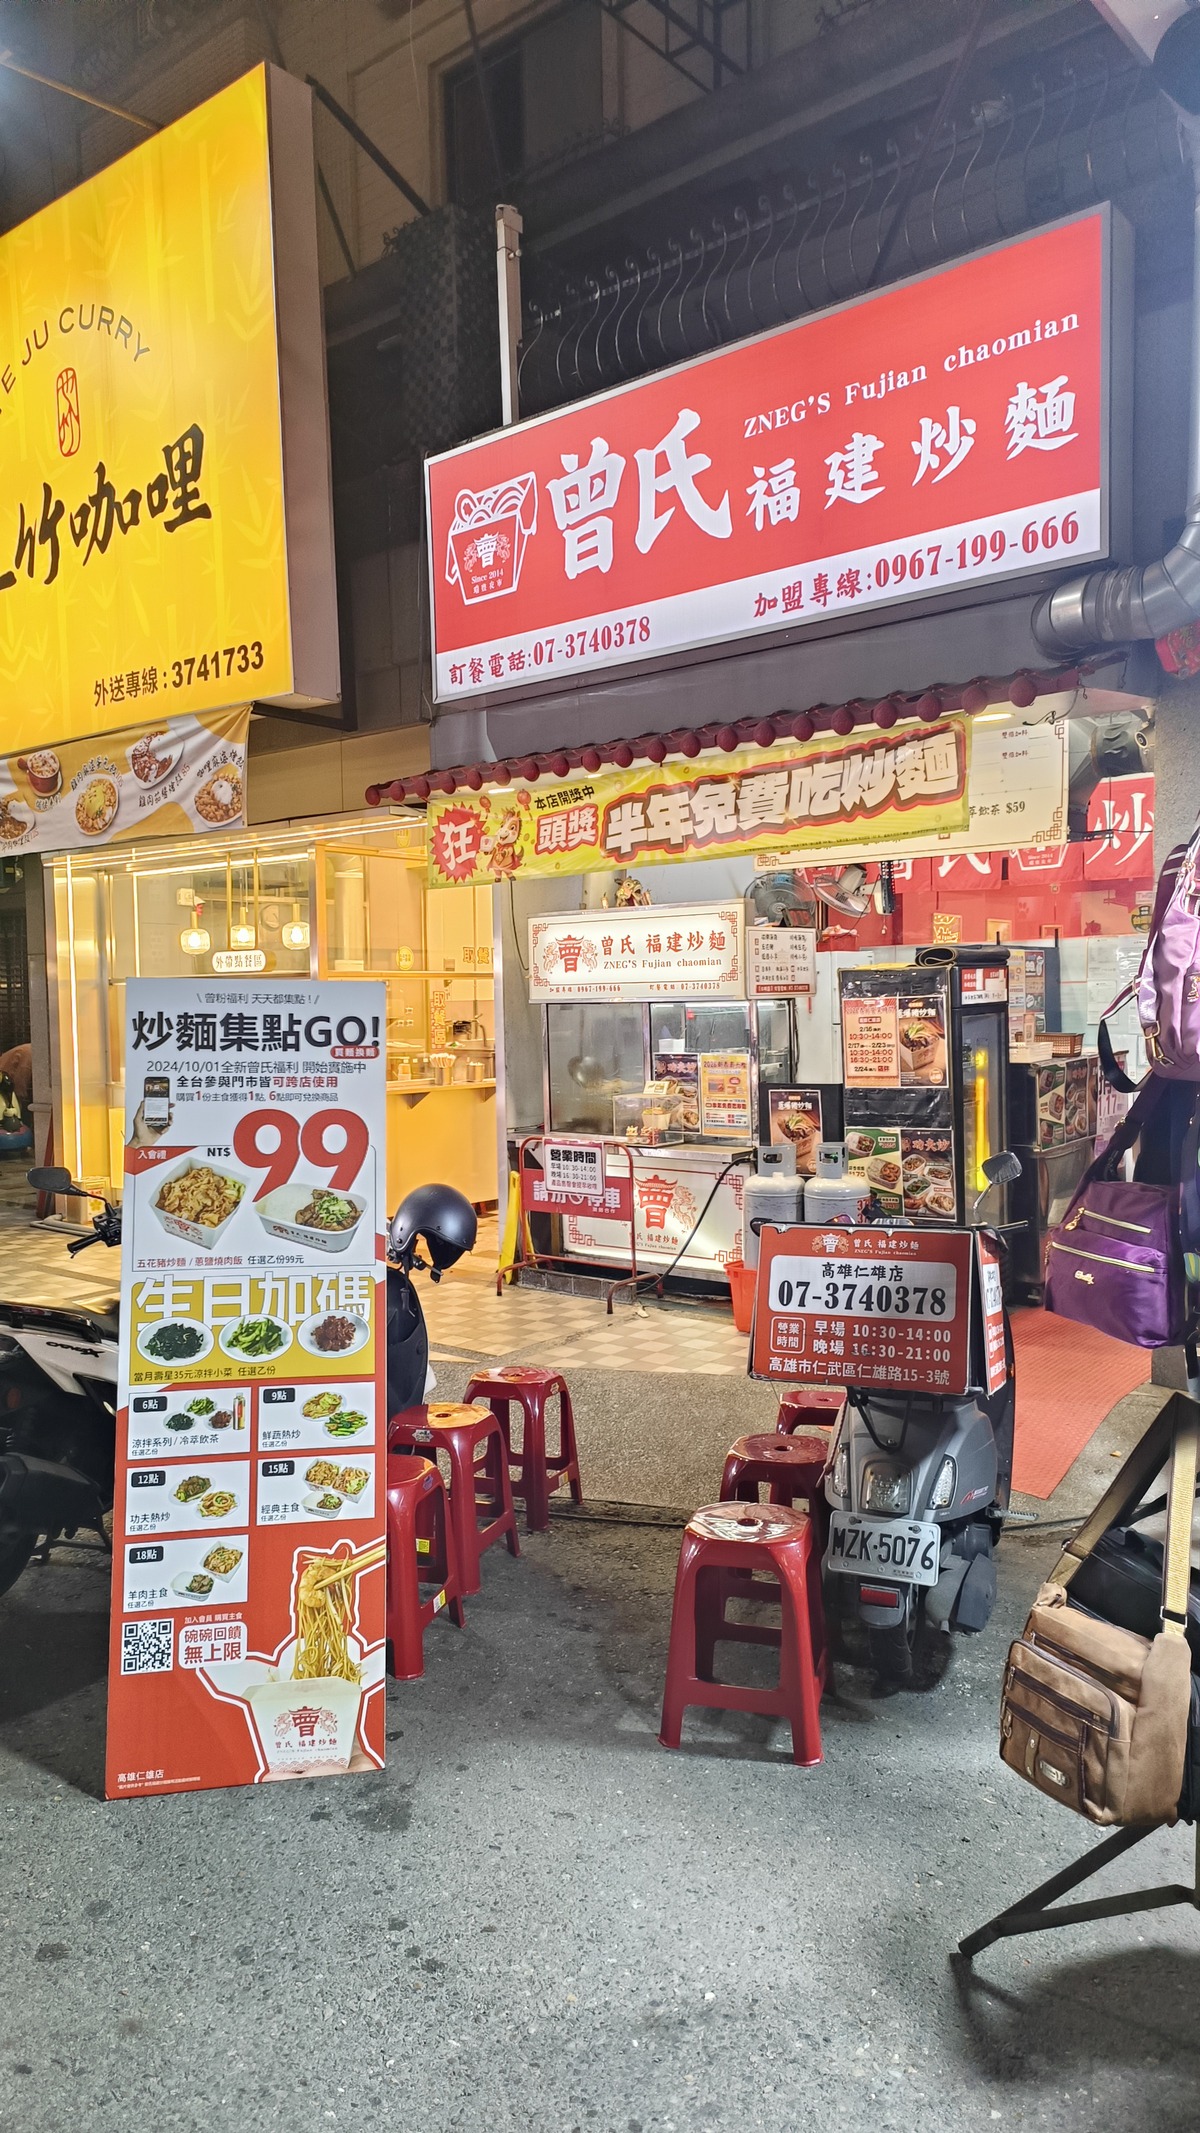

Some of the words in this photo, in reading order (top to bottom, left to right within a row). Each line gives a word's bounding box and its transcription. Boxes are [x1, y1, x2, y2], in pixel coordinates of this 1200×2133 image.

[22, 320, 49, 366] JU
[59, 303, 150, 362] CURRY
[744, 392, 831, 439] ZNEG'S
[845, 362, 928, 408] Fujian
[942, 312, 1080, 374] chaomian
[546, 408, 731, 581] 曾氏
[745, 375, 1079, 531] 福建炒麵
[0, 423, 212, 585] 竹咖哩
[534, 785, 595, 811] 本店開獎中
[605, 731, 959, 854] 半年免費吃炒麵
[1006, 801, 1026, 815] $59
[538, 806, 598, 851] 頭獎
[440, 819, 476, 871] 狂
[601, 935, 636, 956] 曾氏
[646, 930, 727, 953] 福建炒麵
[463, 947, 494, 964] 取餐
[603, 959, 637, 970] ZNEG'S
[642, 959, 672, 969] Fujian
[677, 957, 722, 967] chaomian
[204, 993, 248, 1004] 曾粉福利
[132, 1011, 380, 1052] 炒麵集點GO!
[176, 1076, 338, 1089] 全台參與門市皆可跨店使用
[137, 1150, 167, 1161] 入會禮
[207, 1147, 231, 1157] NT$
[233, 1108, 369, 1203] 99
[550, 1149, 597, 1164] 營業時間
[853, 1238, 873, 1249] 曾氏
[877, 1239, 919, 1251] 福建炒麵
[137, 1256, 187, 1268] 五花豬炒麵
[247, 1254, 305, 1265] 任選乙份99元
[821, 1261, 904, 1282] 高雄仁雄店
[136, 1271, 371, 1333] 生日加碼
[778, 1280, 946, 1317] 07-3740378
[813, 1320, 845, 1337] 早場
[852, 1323, 951, 1343] 10:30-14:00
[812, 1339, 845, 1356] 晚場
[852, 1342, 951, 1362] 16:30-21:00
[238, 1366, 276, 1376] 任選乙份
[768, 1356, 950, 1386] 高雄市仁武區仁雄路15-3號
[271, 1391, 287, 1401] 9點
[142, 1400, 159, 1410] 6點
[132, 1438, 173, 1449] 涼拌系列
[179, 1434, 219, 1446] 冷萃飲茶
[262, 1429, 301, 1441] 鮮蔬熱炒
[262, 1440, 288, 1448] 任選乙份
[131, 1448, 159, 1456] 任選乙份
[268, 1464, 289, 1474] 15點
[137, 1474, 160, 1485] 12點
[261, 1503, 300, 1514] 經典主食
[130, 1512, 171, 1524] 功夫熱炒
[261, 1514, 287, 1522] 任選乙份
[129, 1523, 157, 1532] 任選乙份
[135, 1550, 157, 1561] 18點
[127, 1587, 168, 1599] 羊肉主食
[127, 1600, 155, 1608] 任選乙份
[184, 1614, 213, 1624] 加入會員
[214, 1612, 243, 1623] 購買主食
[184, 1626, 242, 1643] 碗碗回饋
[184, 1642, 242, 1665] 無上限
[118, 1769, 165, 1783] 高雄仁雄店
